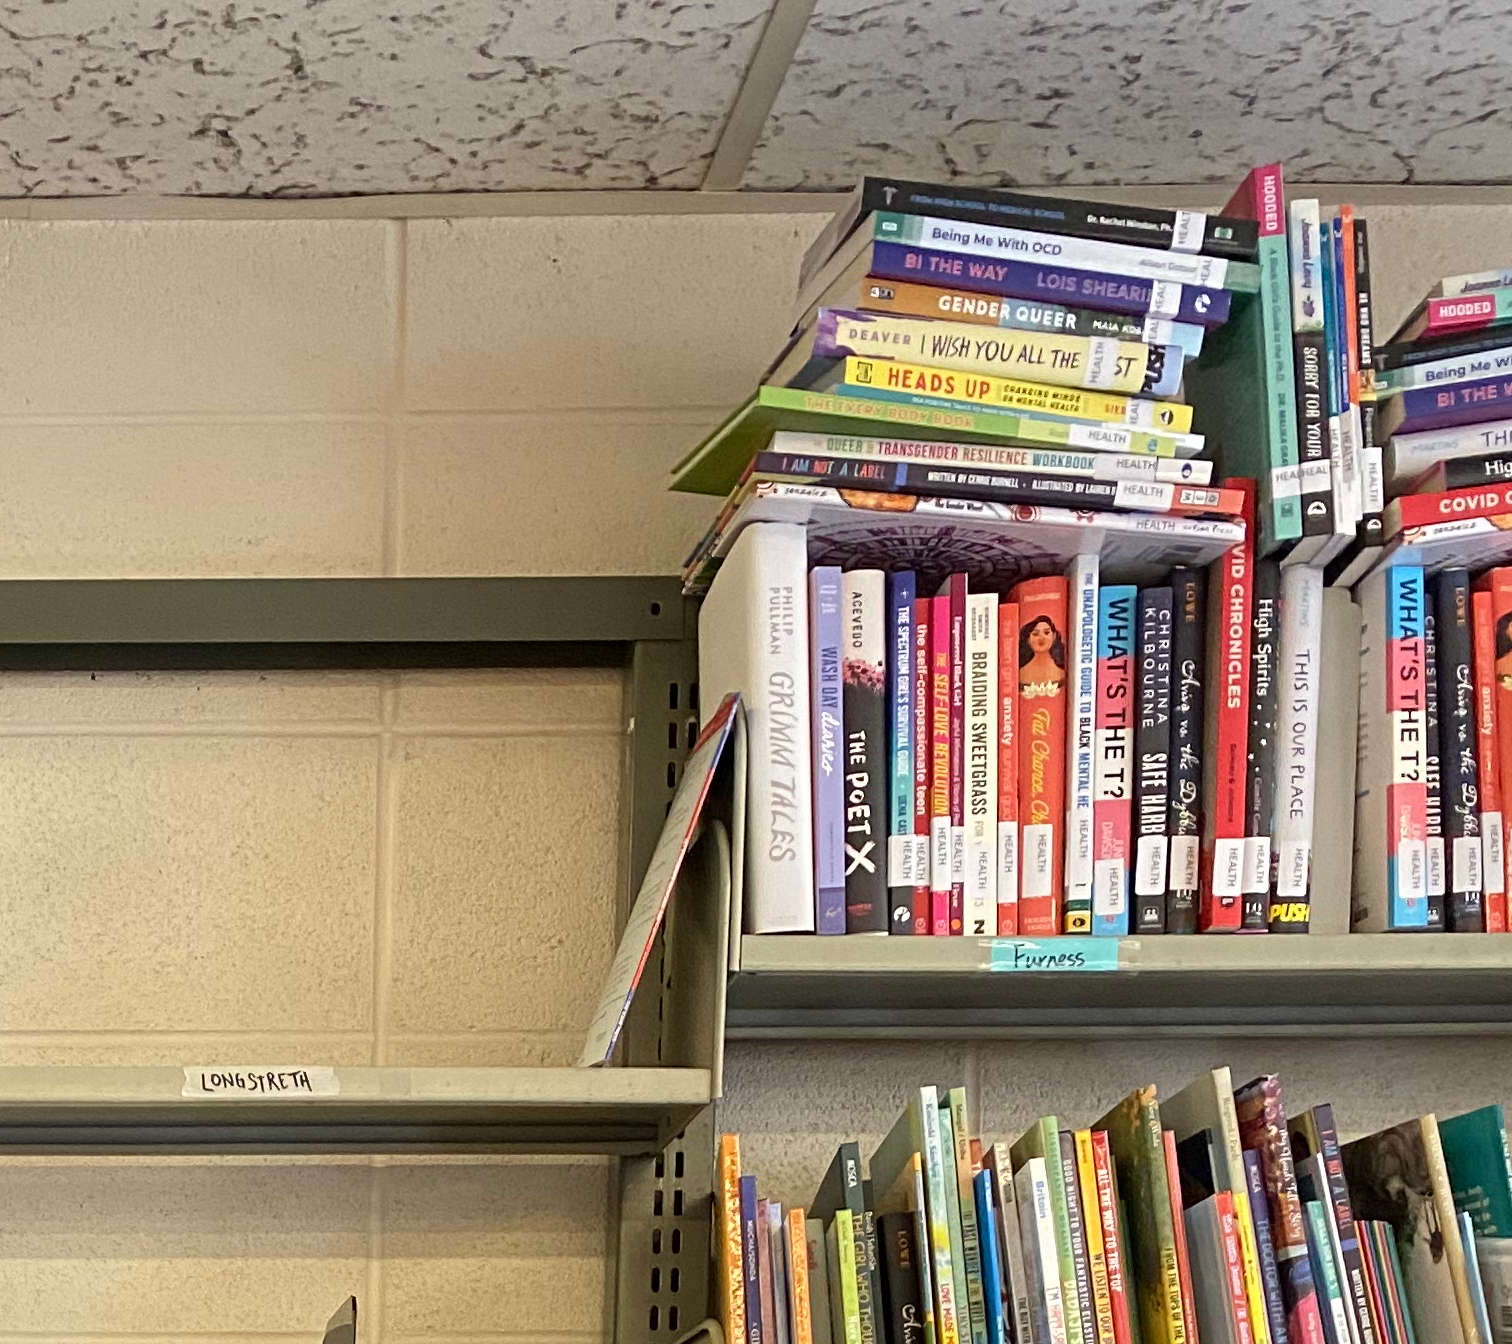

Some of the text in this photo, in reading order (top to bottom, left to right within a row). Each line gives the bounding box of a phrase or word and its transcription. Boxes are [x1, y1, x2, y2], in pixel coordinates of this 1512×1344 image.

[1264, 175, 1278, 231] HOODED
[932, 226, 1062, 256] Being Me With OCD
[905, 253, 922, 271] BI
[929, 256, 963, 277] THE
[969, 261, 1008, 282] WAY
[1037, 271, 1076, 292] LOIS
[938, 295, 1077, 330] GENDER QUEER
[1440, 302, 1491, 317] HOODED
[848, 327, 1081, 370] DEAVER I WISH YOU ALL THE
[1425, 361, 1490, 382] Being Me
[887, 366, 991, 399] HEADS UP
[1438, 385, 1497, 408] BI THE
[826, 436, 1095, 470] QUEER TRANSGENDER RESILIENCE WORKBOOK
[1088, 430, 1126, 444] HEALTH
[1136, 518, 1176, 531] HEALTH
[1440, 492, 1500, 514] COVID
[770, 587, 781, 655] PULLMAN
[783, 586, 793, 636] PHILIP
[852, 591, 862, 648] ACEVEDO
[1226, 544, 1246, 709] VID CHRONICLES
[1142, 607, 1157, 728] KILBOURNE
[1157, 610, 1170, 724] CHRISTINA
[1253, 598, 1274, 697] High Spirits
[972, 652, 987, 717] BRAIDING
[1104, 597, 1130, 799] WHAT'S THE T?
[1400, 579, 1420, 783] WHAT'S THE T?
[934, 675, 949, 737] SELF-LOVE
[1289, 648, 1310, 819] THIS IS OUR PLACE
[768, 670, 796, 862] GRIMM TALES
[934, 743, 949, 815] REVOLUTION
[971, 722, 988, 815] SWEETGRASS
[845, 730, 876, 876] THE POET X
[1141, 753, 1167, 838] SAFE HARB
[953, 834, 962, 873] HEALTH
[1150, 846, 1160, 886] HEALTH
[1292, 846, 1303, 888] HEALTH
[1269, 904, 1310, 923] PUSH
[200, 1071, 314, 1094] LONGSTRETH
[1035, 1180, 1046, 1219] Britain
